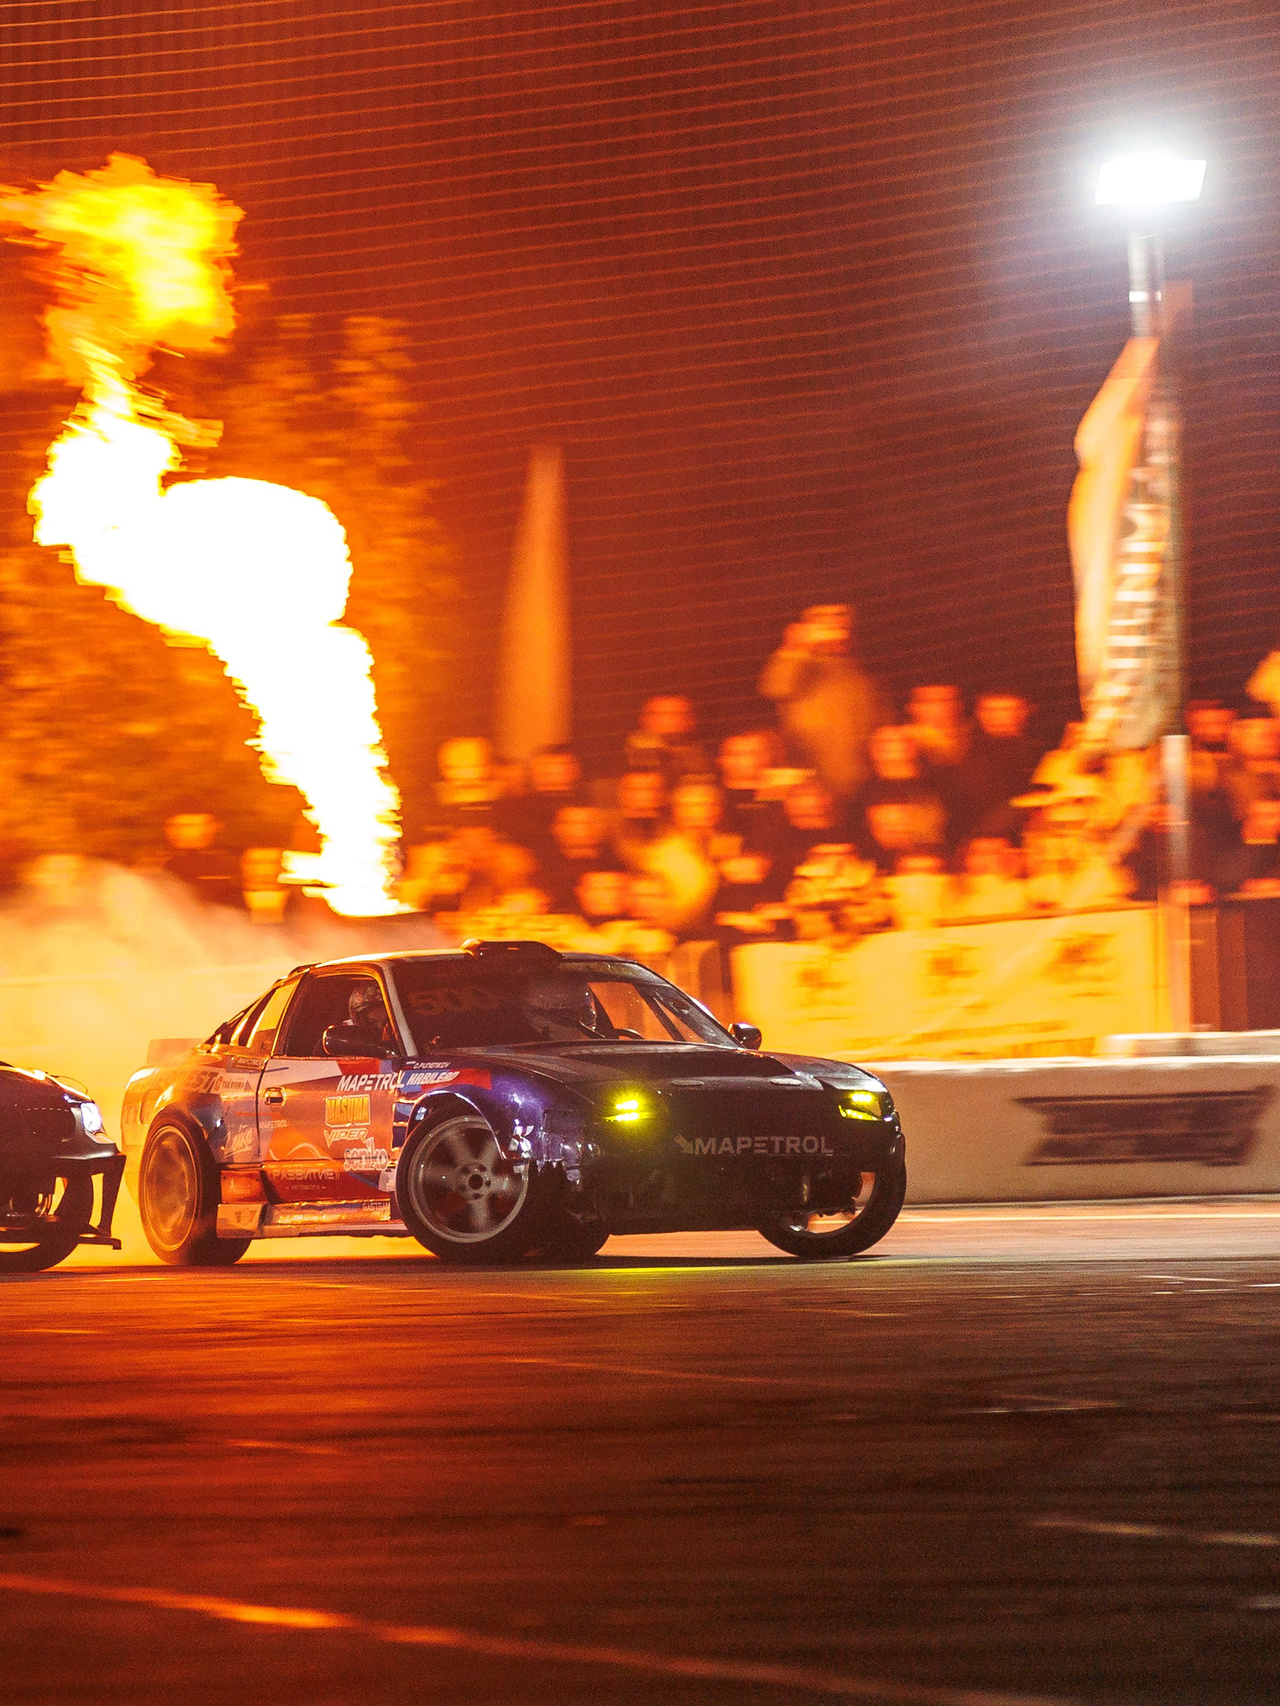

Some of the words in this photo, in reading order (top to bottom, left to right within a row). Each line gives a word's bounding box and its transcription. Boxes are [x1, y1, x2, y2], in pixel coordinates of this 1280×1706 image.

[336, 1072, 405, 1092] MAPETROL
[325, 1095, 370, 1126] MASUMA
[324, 1127, 368, 1148] VIPER
[695, 1135, 834, 1156] MAPETROL
